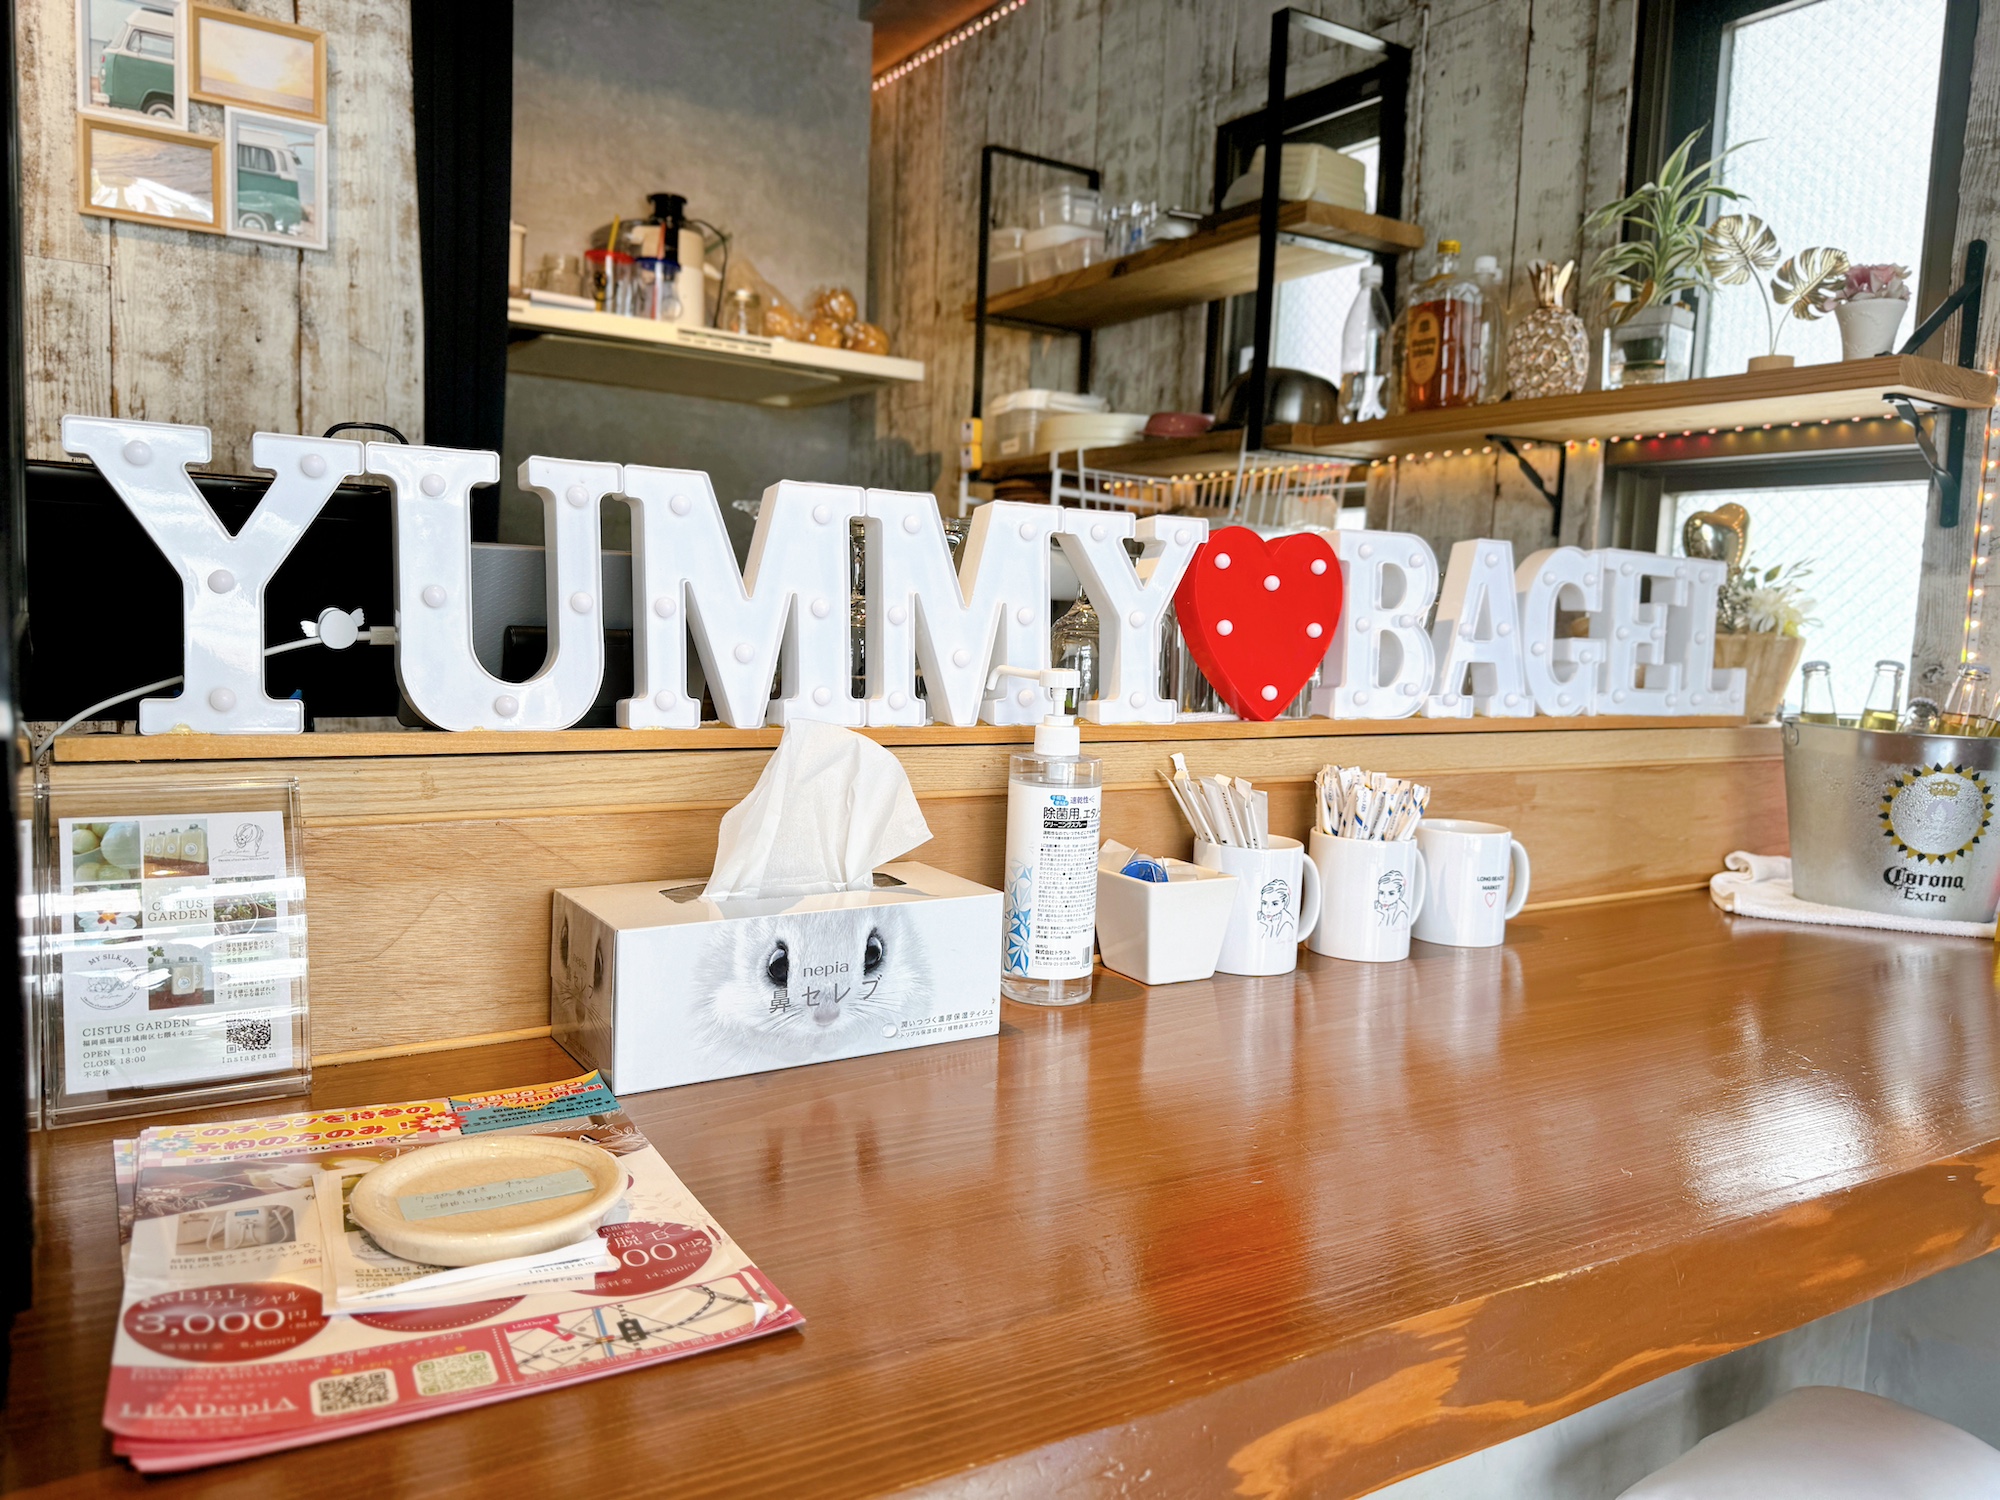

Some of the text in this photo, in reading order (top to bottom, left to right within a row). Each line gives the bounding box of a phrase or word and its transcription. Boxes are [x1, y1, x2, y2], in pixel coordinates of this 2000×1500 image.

[62, 414, 1747, 735] YUMMY BAGEL
[1883, 865, 1965, 891] Corona
[1903, 886, 1947, 903] Extra
[152, 899, 203, 911] CTUS
[147, 909, 208, 922] GARDEN
[87, 955, 101, 966] MY
[102, 953, 122, 961] SILK
[802, 961, 850, 978] nepia
[769, 973, 883, 1014] 鼻セレブ
[82, 1019, 191, 1037] CISTUS GARDEN
[83, 1046, 147, 1059] OPEN 11:00
[222, 1052, 277, 1063] Instagram
[83, 1056, 146, 1069] CLOSE 18:00
[84, 1069, 111, 1078] 不定休
[173, 1105, 432, 1139] このチラシを持参の
[192, 1125, 387, 1152] 予約の方のみ
[354, 1266, 412, 1275] CISTUS
[528, 1260, 596, 1274] Instagram
[134, 1308, 308, 1337] 3,000円
